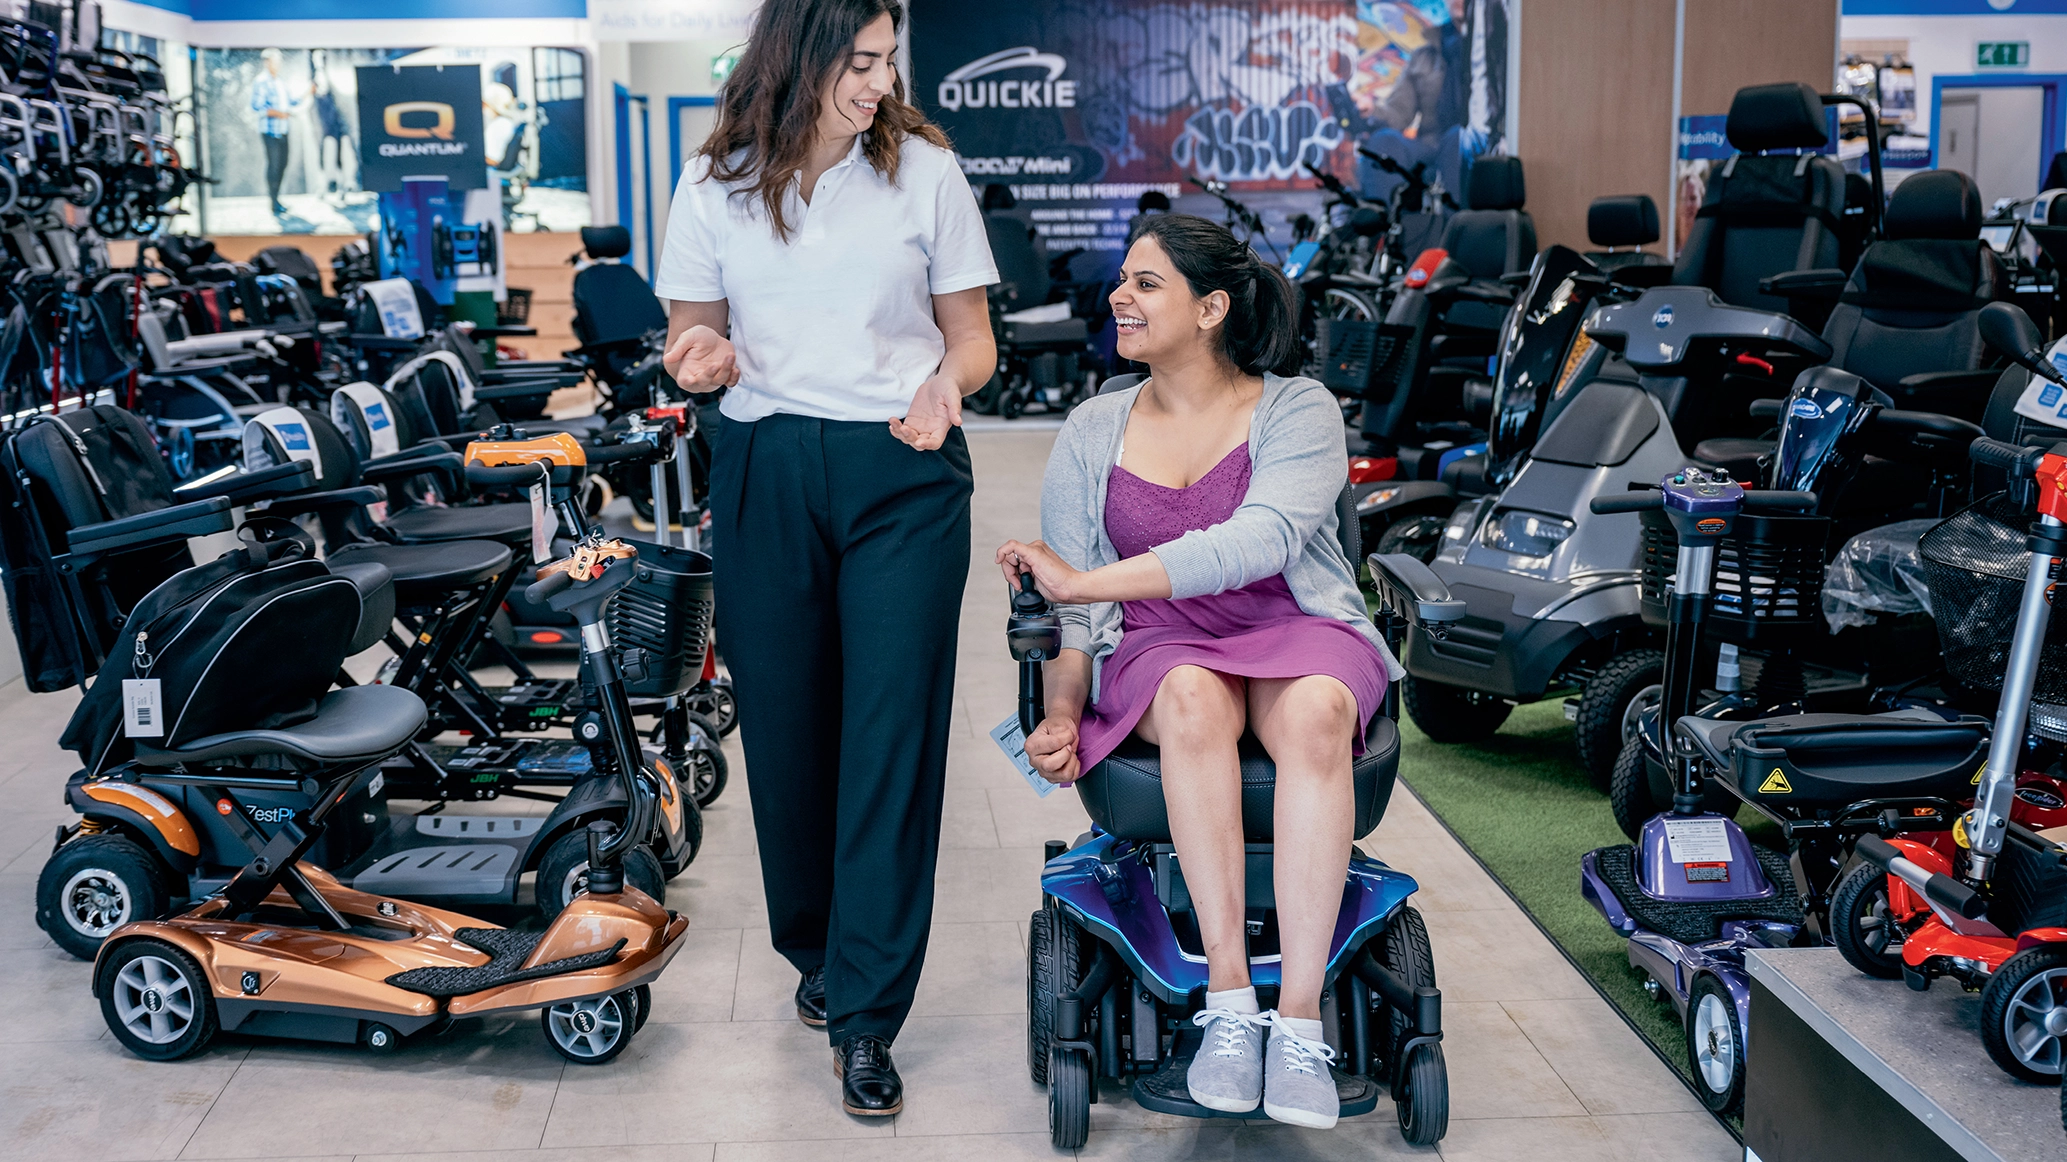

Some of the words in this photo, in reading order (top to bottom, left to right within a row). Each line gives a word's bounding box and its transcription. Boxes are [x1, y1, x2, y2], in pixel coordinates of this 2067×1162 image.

[938, 80, 1076, 112] QUICKIE
[379, 142, 465, 157] QUANTUM
[1024, 157, 1071, 174] Mini
[1021, 183, 1047, 200] SIZE
[1048, 183, 1071, 200] BIG
[1072, 183, 1091, 200] ON
[529, 706, 560, 717] JBH
[470, 773, 500, 783] JBH
[246, 805, 296, 823] ZestPl
